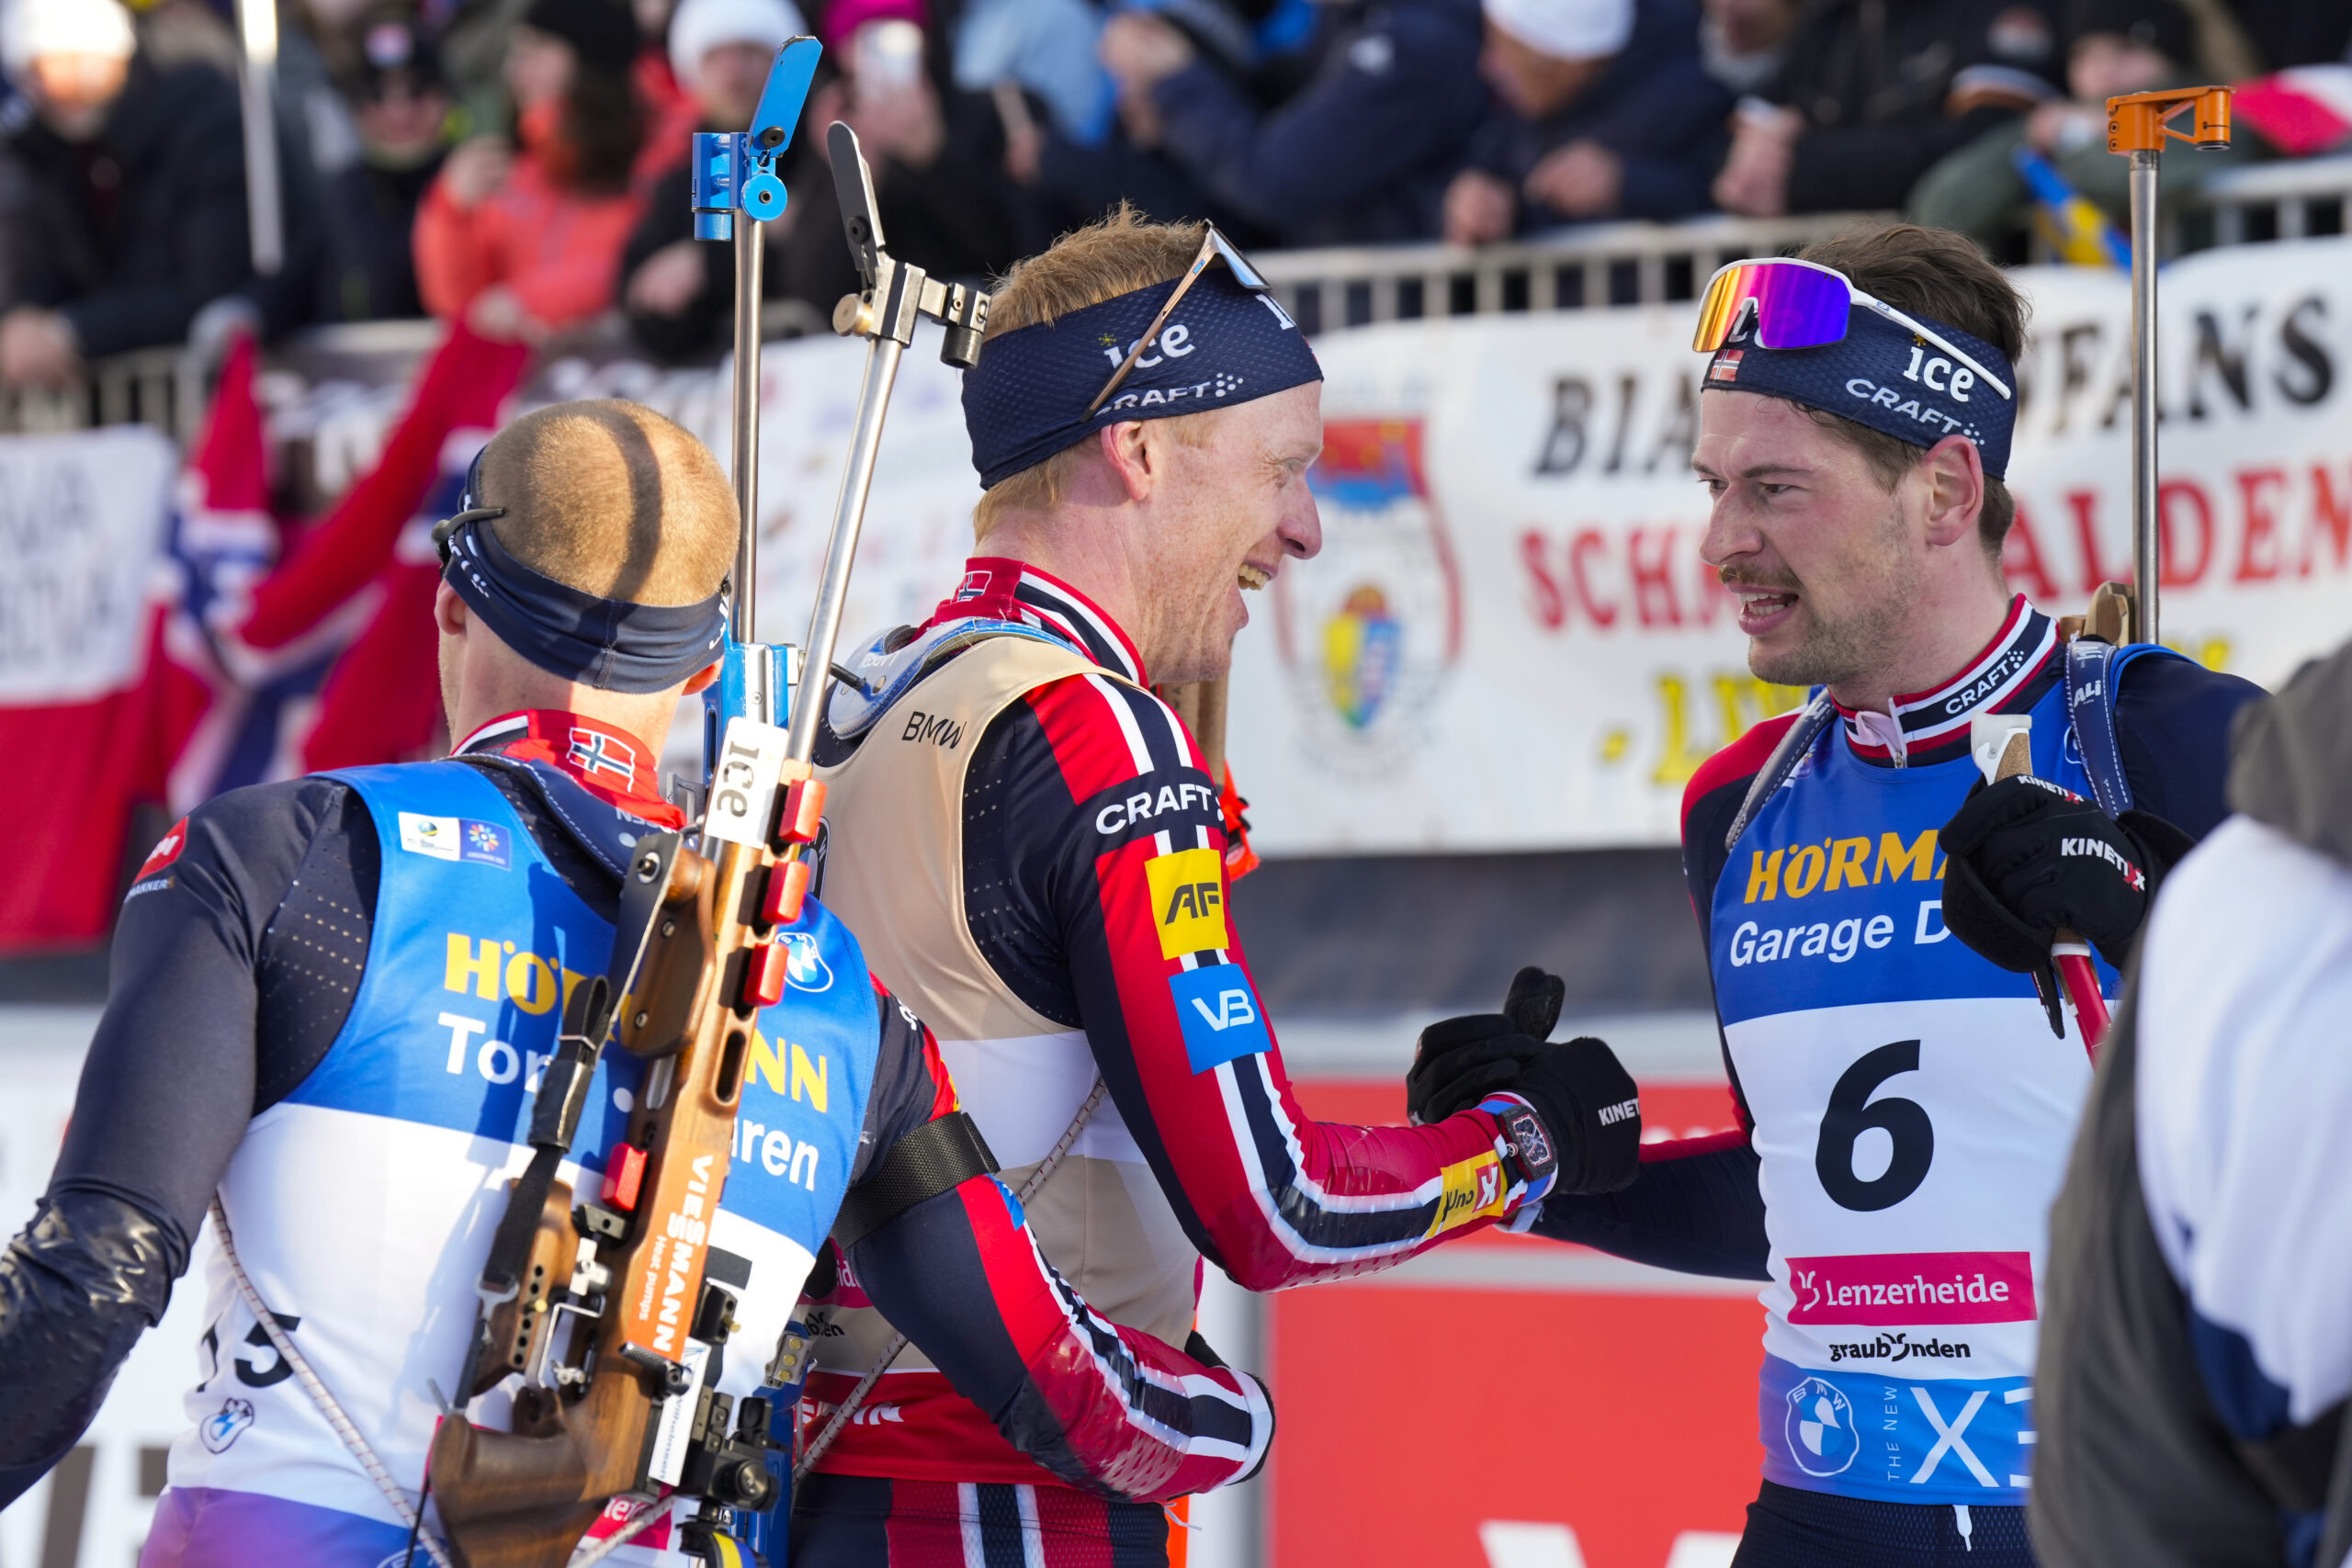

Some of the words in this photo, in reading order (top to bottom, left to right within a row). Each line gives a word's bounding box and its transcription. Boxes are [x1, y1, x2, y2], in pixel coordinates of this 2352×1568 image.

[1903, 342, 1974, 402] ice
[1845, 378, 1962, 434] CRAFT
[1945, 659, 2009, 715] CRAFT
[902, 711, 967, 750] BMW
[1095, 784, 1212, 835] CRAFT
[1744, 829, 1948, 905] HÖRM
[2061, 838, 2145, 892] KINETIXX
[1165, 882, 1221, 926] AF
[1730, 914, 1894, 968] Garage
[1192, 988, 1256, 1032] VB
[1598, 1098, 1639, 1126] KINET
[1815, 1039, 1935, 1213] 6
[650, 1234, 667, 1270] Heat
[652, 1154, 714, 1353] VIESSMANN
[639, 1270, 659, 1322] pumps
[1826, 1274, 2009, 1306] Lenzerheide
[1792, 1382, 1846, 1412] BMW
[1883, 1386, 1899, 1431] NEW
[1887, 1441, 1902, 1482] THE
